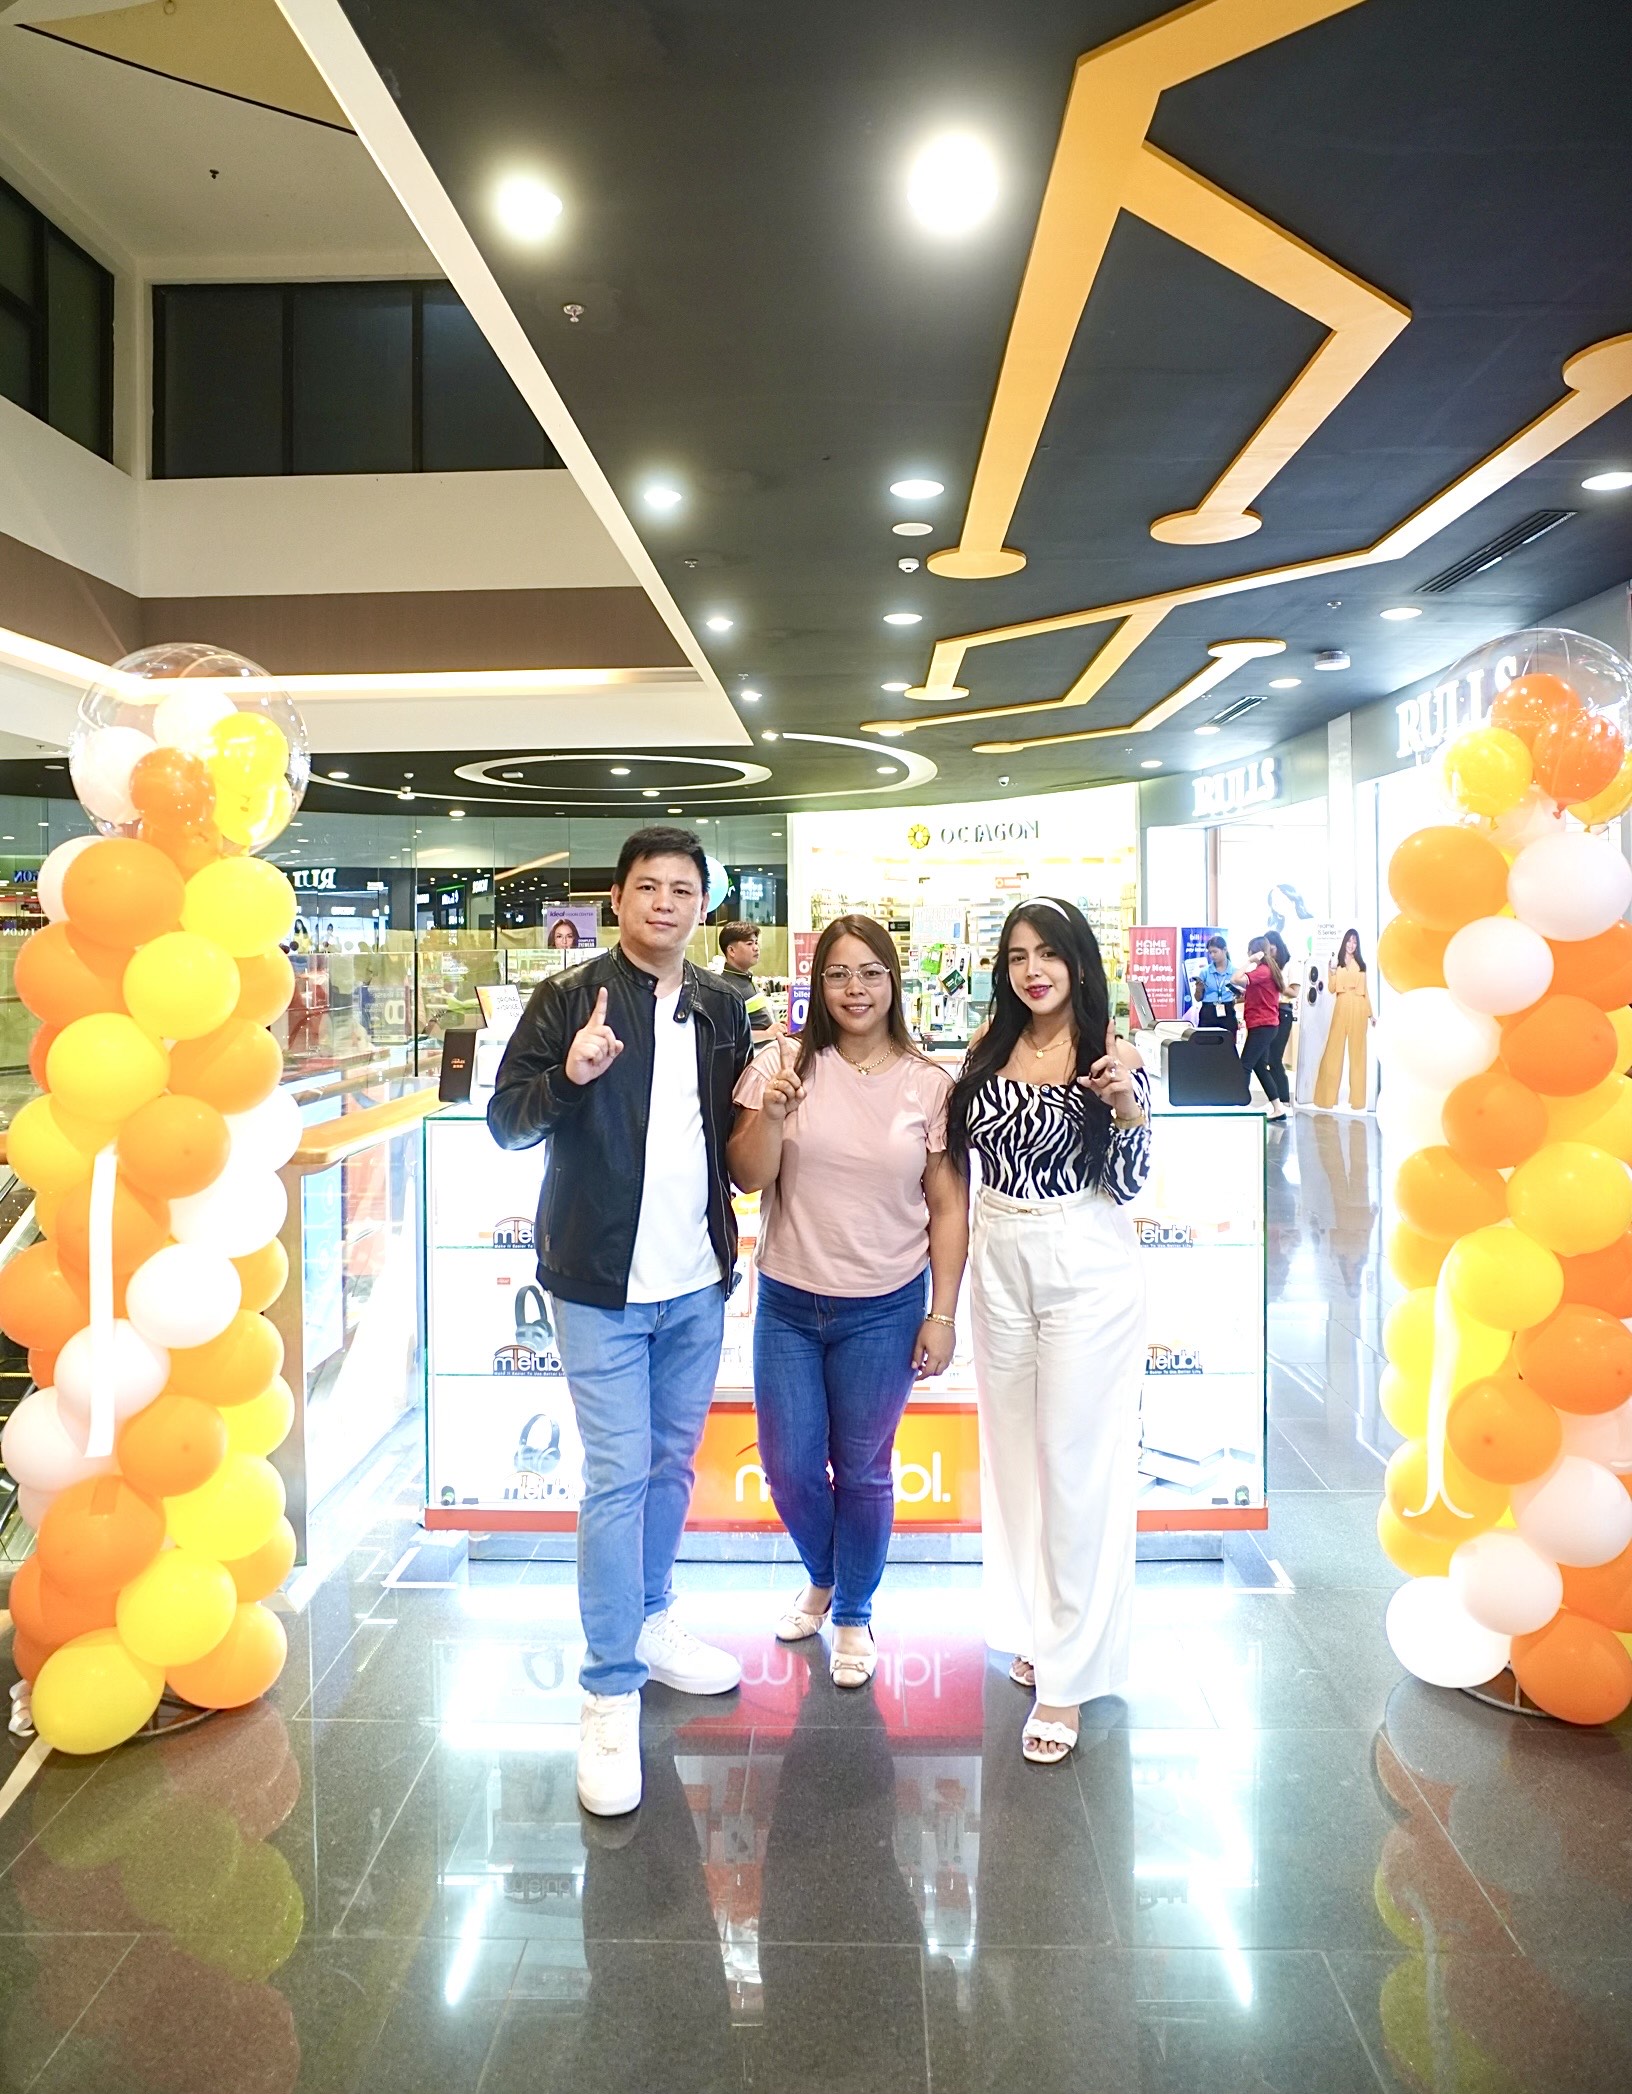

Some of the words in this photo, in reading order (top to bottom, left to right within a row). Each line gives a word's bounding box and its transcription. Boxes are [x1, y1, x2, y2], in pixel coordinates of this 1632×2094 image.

[1192, 757, 1276, 817] RULLS
[940, 819, 1039, 845] OCTAGON
[1135, 940, 1167, 948] HOME
[1135, 947, 1171, 956] CREDIT
[1133, 964, 1150, 973] Buy
[1131, 974, 1149, 983] Pay
[1151, 974, 1175, 982] Later
